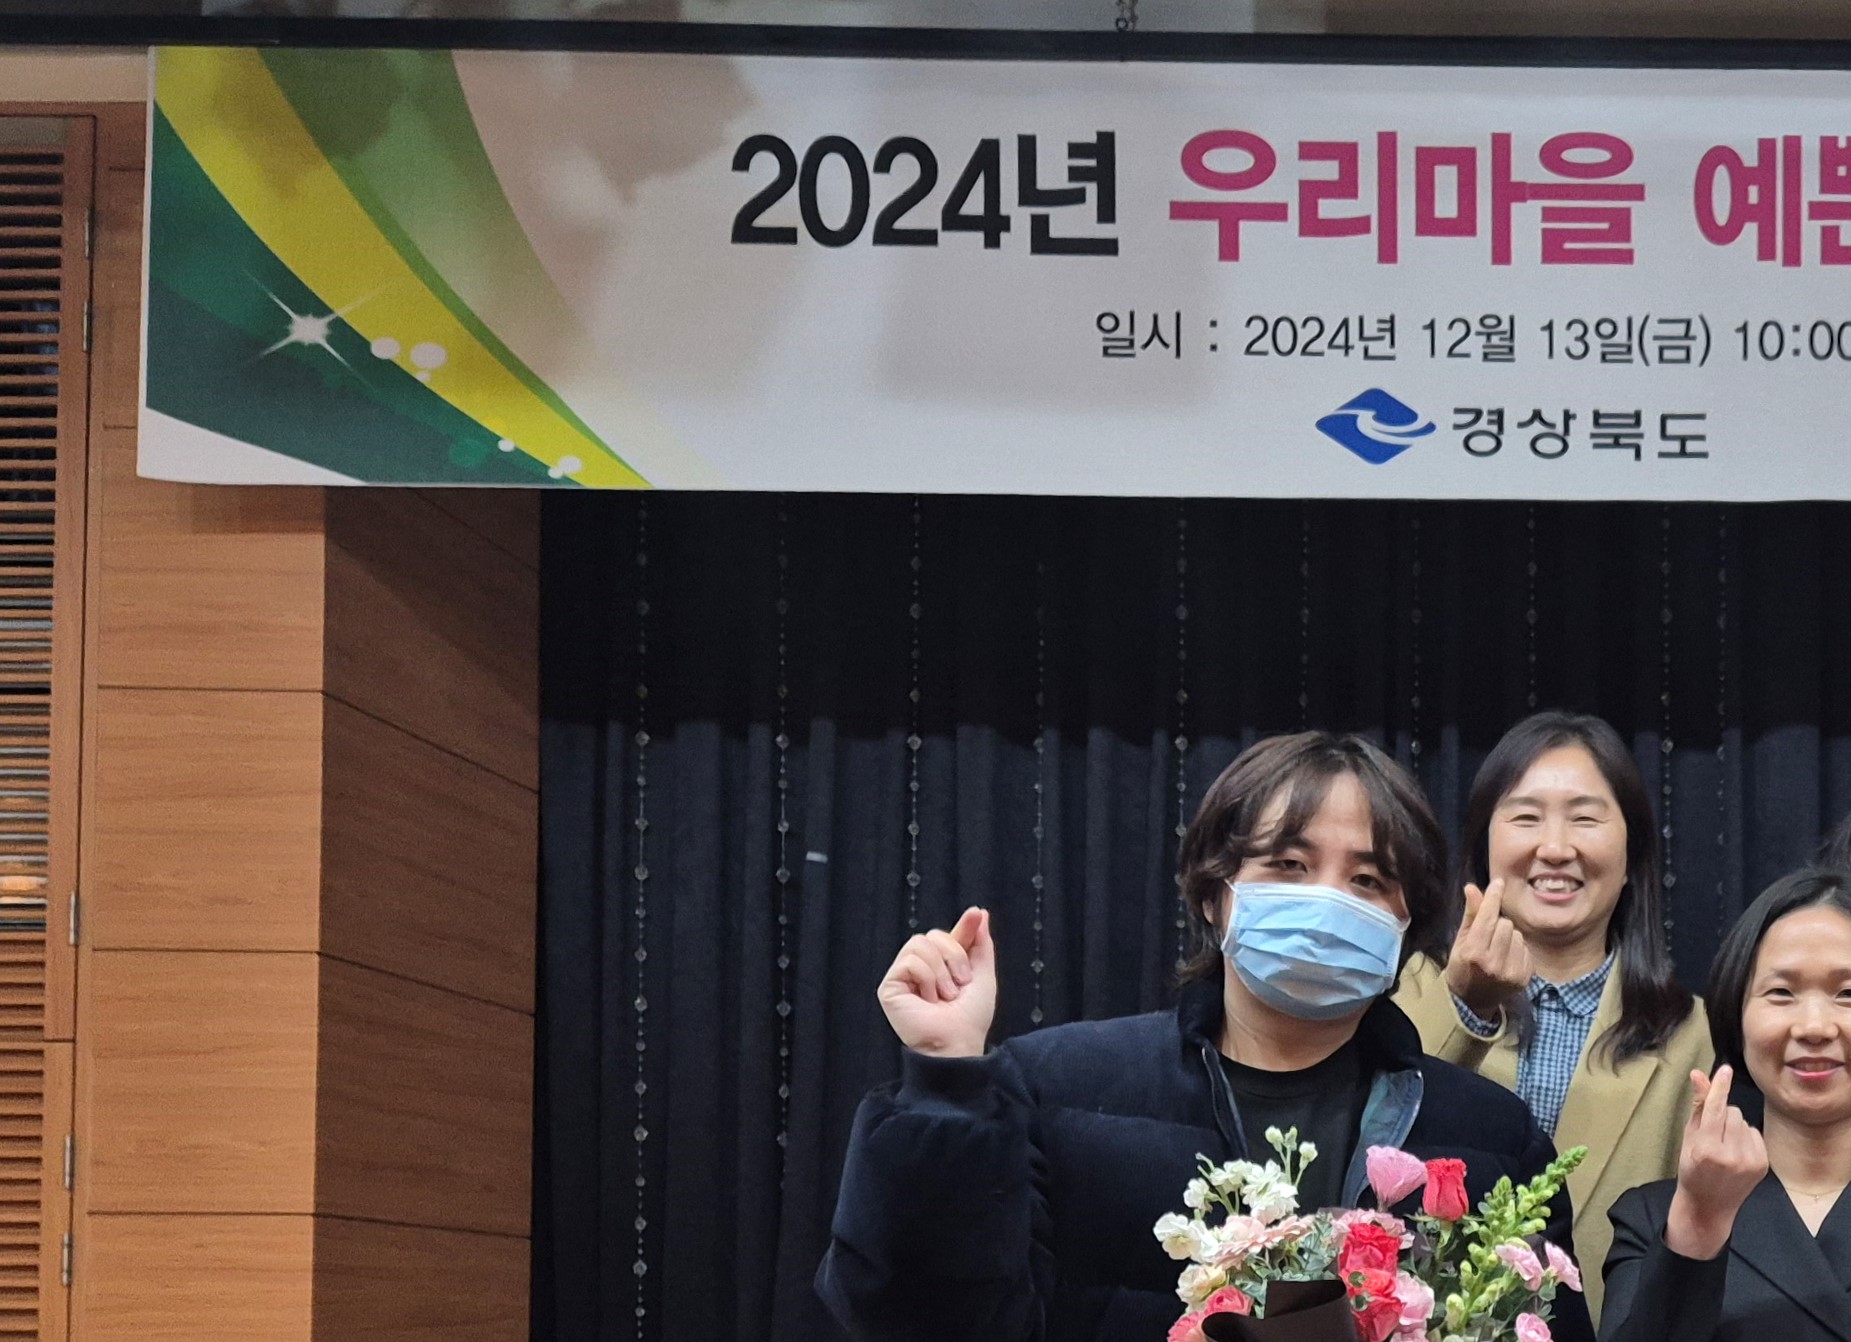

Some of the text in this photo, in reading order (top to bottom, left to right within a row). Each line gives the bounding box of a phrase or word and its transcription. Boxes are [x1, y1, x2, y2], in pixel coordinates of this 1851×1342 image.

[729, 130, 1120, 257] 2024년
[1168, 129, 1646, 266] 우리마을
[1095, 310, 1183, 360] 일시
[1243, 312, 1397, 362] 2024년
[1421, 314, 1517, 364] 12월
[1539, 314, 1712, 367] 13일(금)
[1452, 406, 1710, 463] 경상북도
